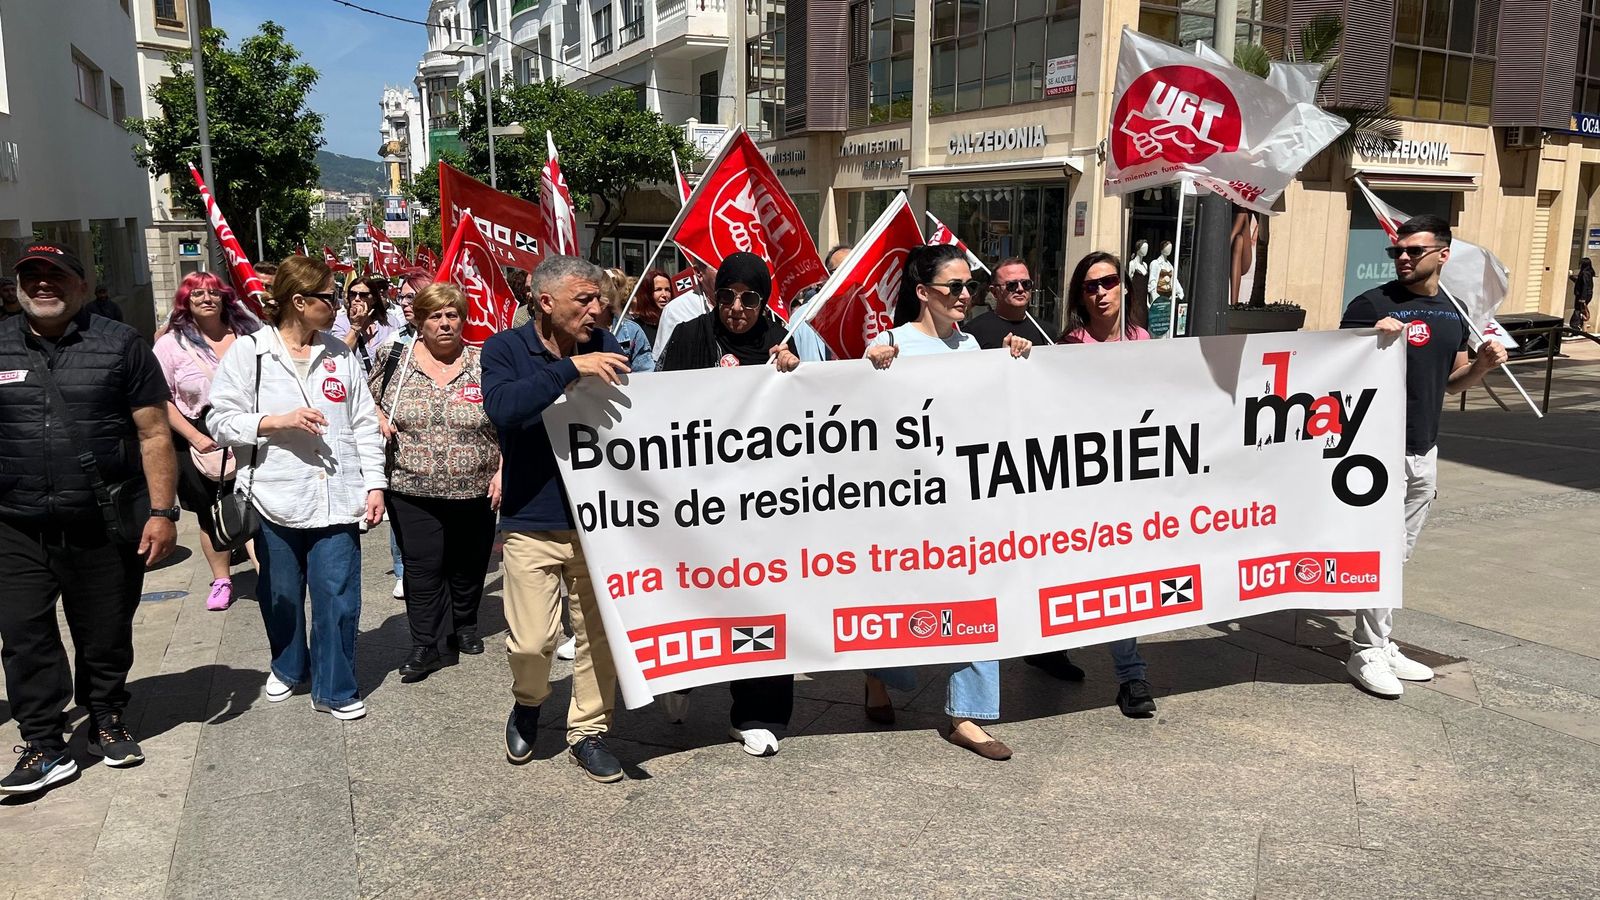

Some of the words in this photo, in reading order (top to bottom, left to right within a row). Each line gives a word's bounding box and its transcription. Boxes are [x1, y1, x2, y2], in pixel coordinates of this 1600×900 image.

[1142, 80, 1225, 140] UGT
[1581, 117, 1600, 133] OCA
[947, 125, 1046, 156] CALZEDONIA
[1124, 168, 1158, 183] miembro
[1161, 163, 1185, 174] funda
[487, 241, 516, 262] UTA
[1357, 262, 1396, 280] CALZE
[1409, 323, 1428, 335] UGT
[567, 404, 878, 471] Bonificación
[895, 398, 945, 456] sí,
[576, 490, 660, 535] plus
[674, 488, 726, 528] de
[739, 469, 947, 521] residencia
[955, 408, 1210, 501] TAMBIÉN.
[606, 567, 663, 600] ara
[676, 557, 788, 590] todos
[800, 547, 857, 579] los
[868, 521, 1133, 577] trabajadores/as
[1142, 511, 1180, 542] de
[1189, 501, 1277, 535] Ceuta
[1240, 561, 1291, 591] UGT
[1340, 572, 1378, 584] Ceuta
[1048, 581, 1153, 626] CCOO
[836, 612, 904, 642] UGT
[956, 622, 996, 635] Ceuta
[629, 627, 722, 671] COO
